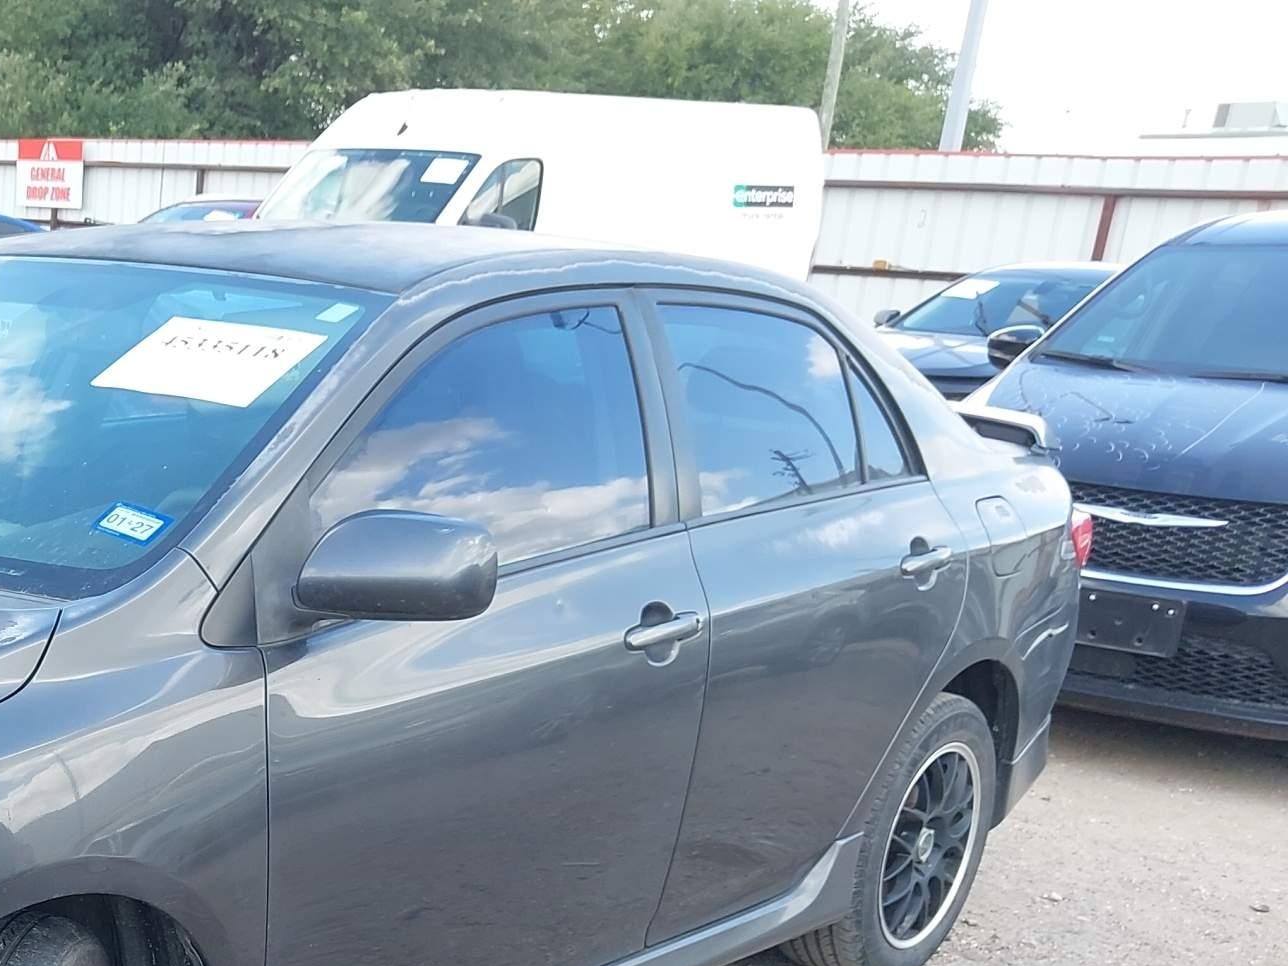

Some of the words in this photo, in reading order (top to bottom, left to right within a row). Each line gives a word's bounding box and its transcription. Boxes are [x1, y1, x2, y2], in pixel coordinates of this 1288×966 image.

[30, 166, 66, 182] GENERAL
[26, 185, 49, 201] DROP
[50, 186, 72, 202] ZONE
[734, 187, 794, 206] enterprise
